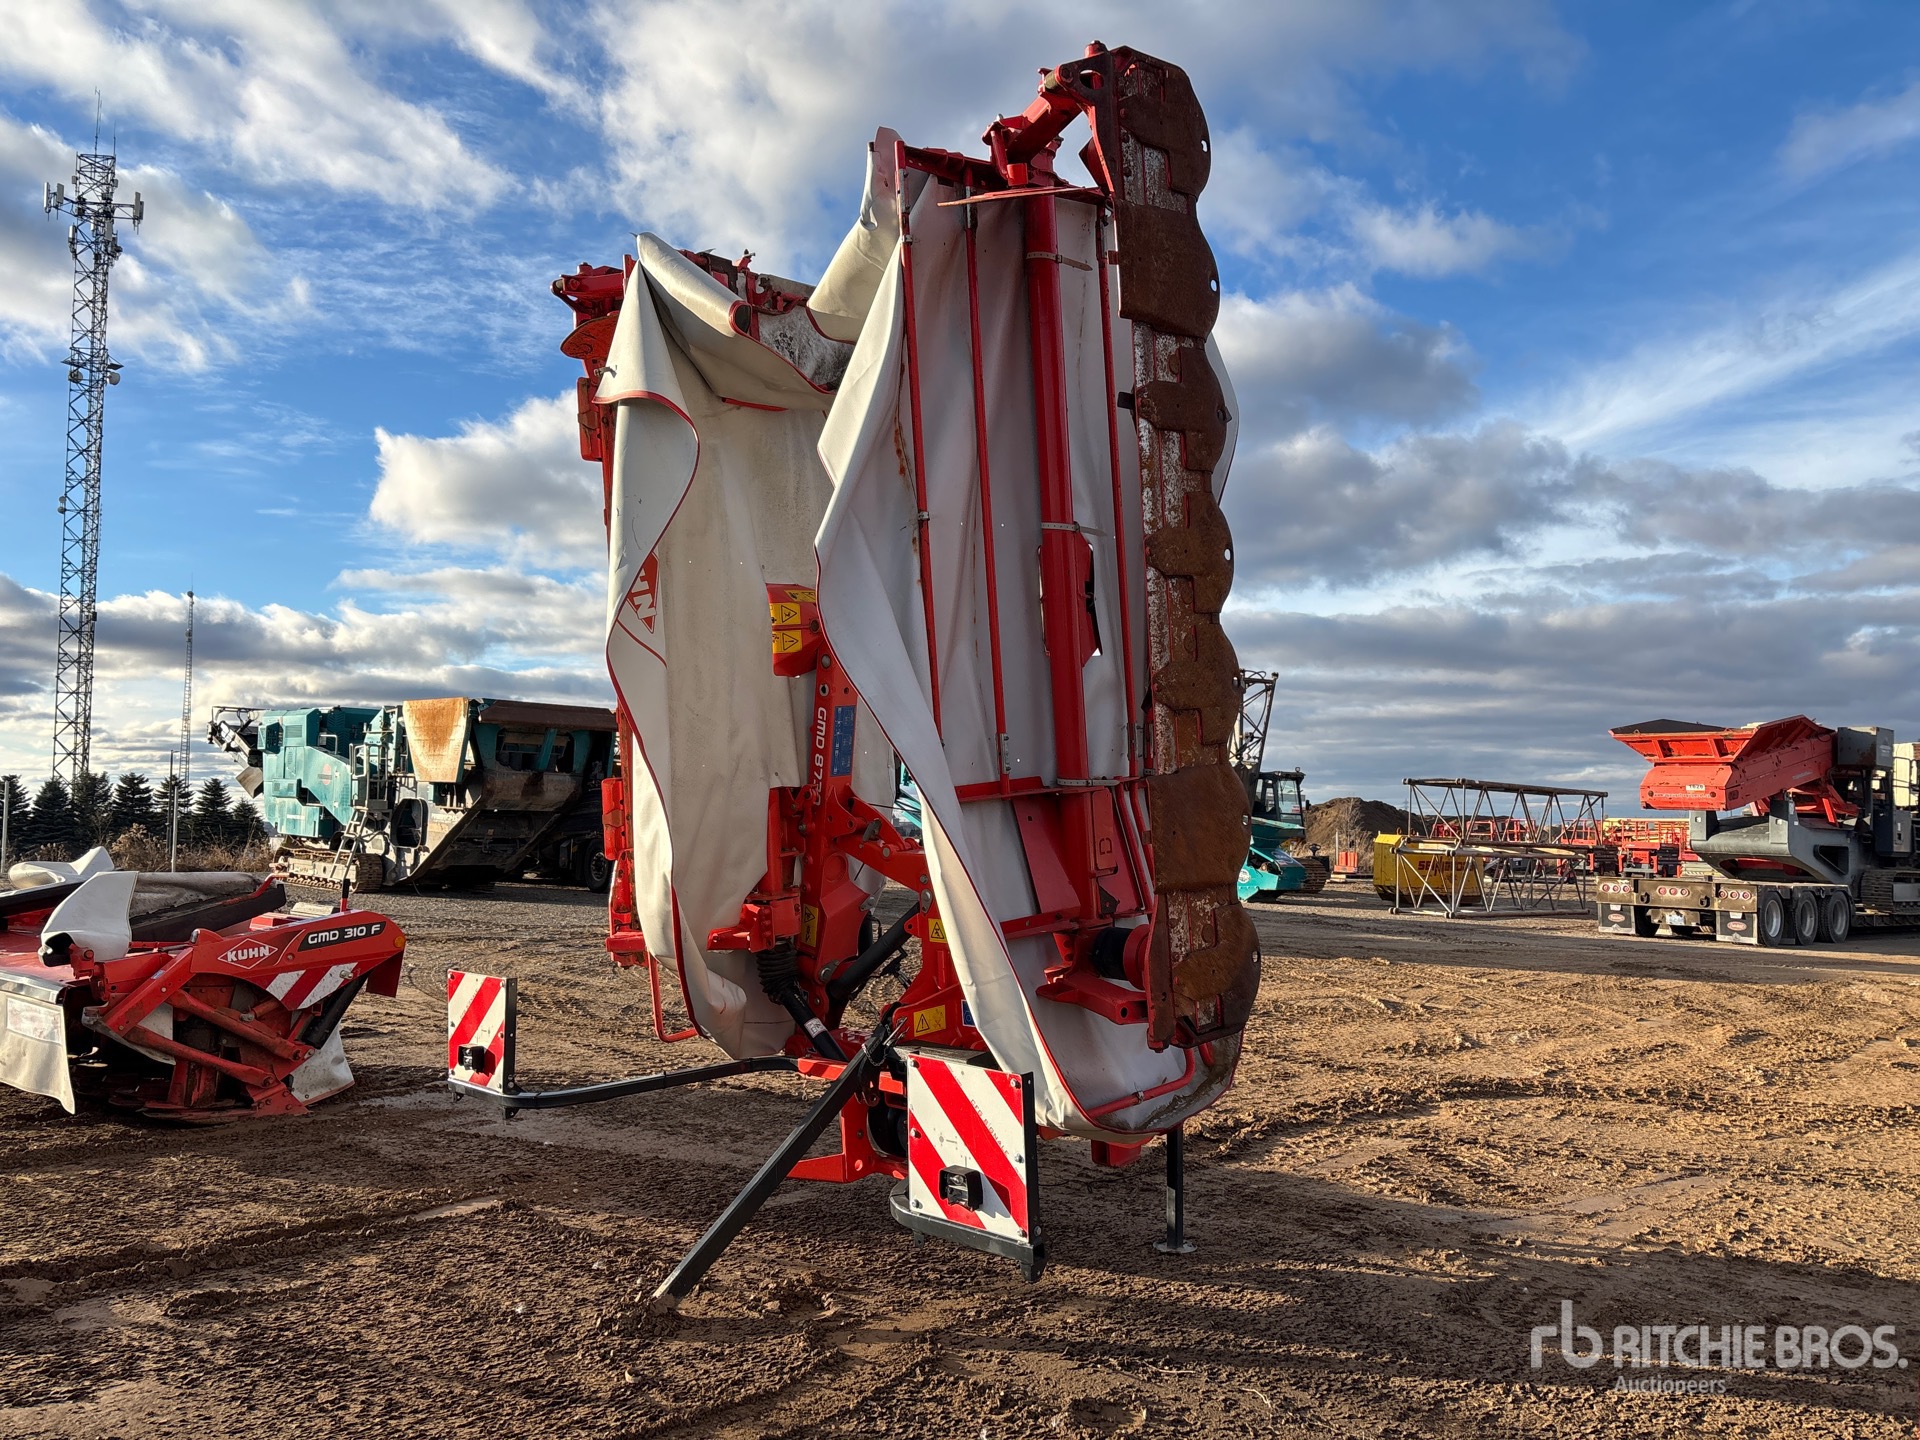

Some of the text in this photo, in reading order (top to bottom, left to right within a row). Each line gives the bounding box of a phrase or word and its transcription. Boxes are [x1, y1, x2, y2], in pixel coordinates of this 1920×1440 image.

[815, 707, 827, 749] GMD
[307, 924, 381, 944] GMD 310 F
[227, 946, 270, 962] KUHN
